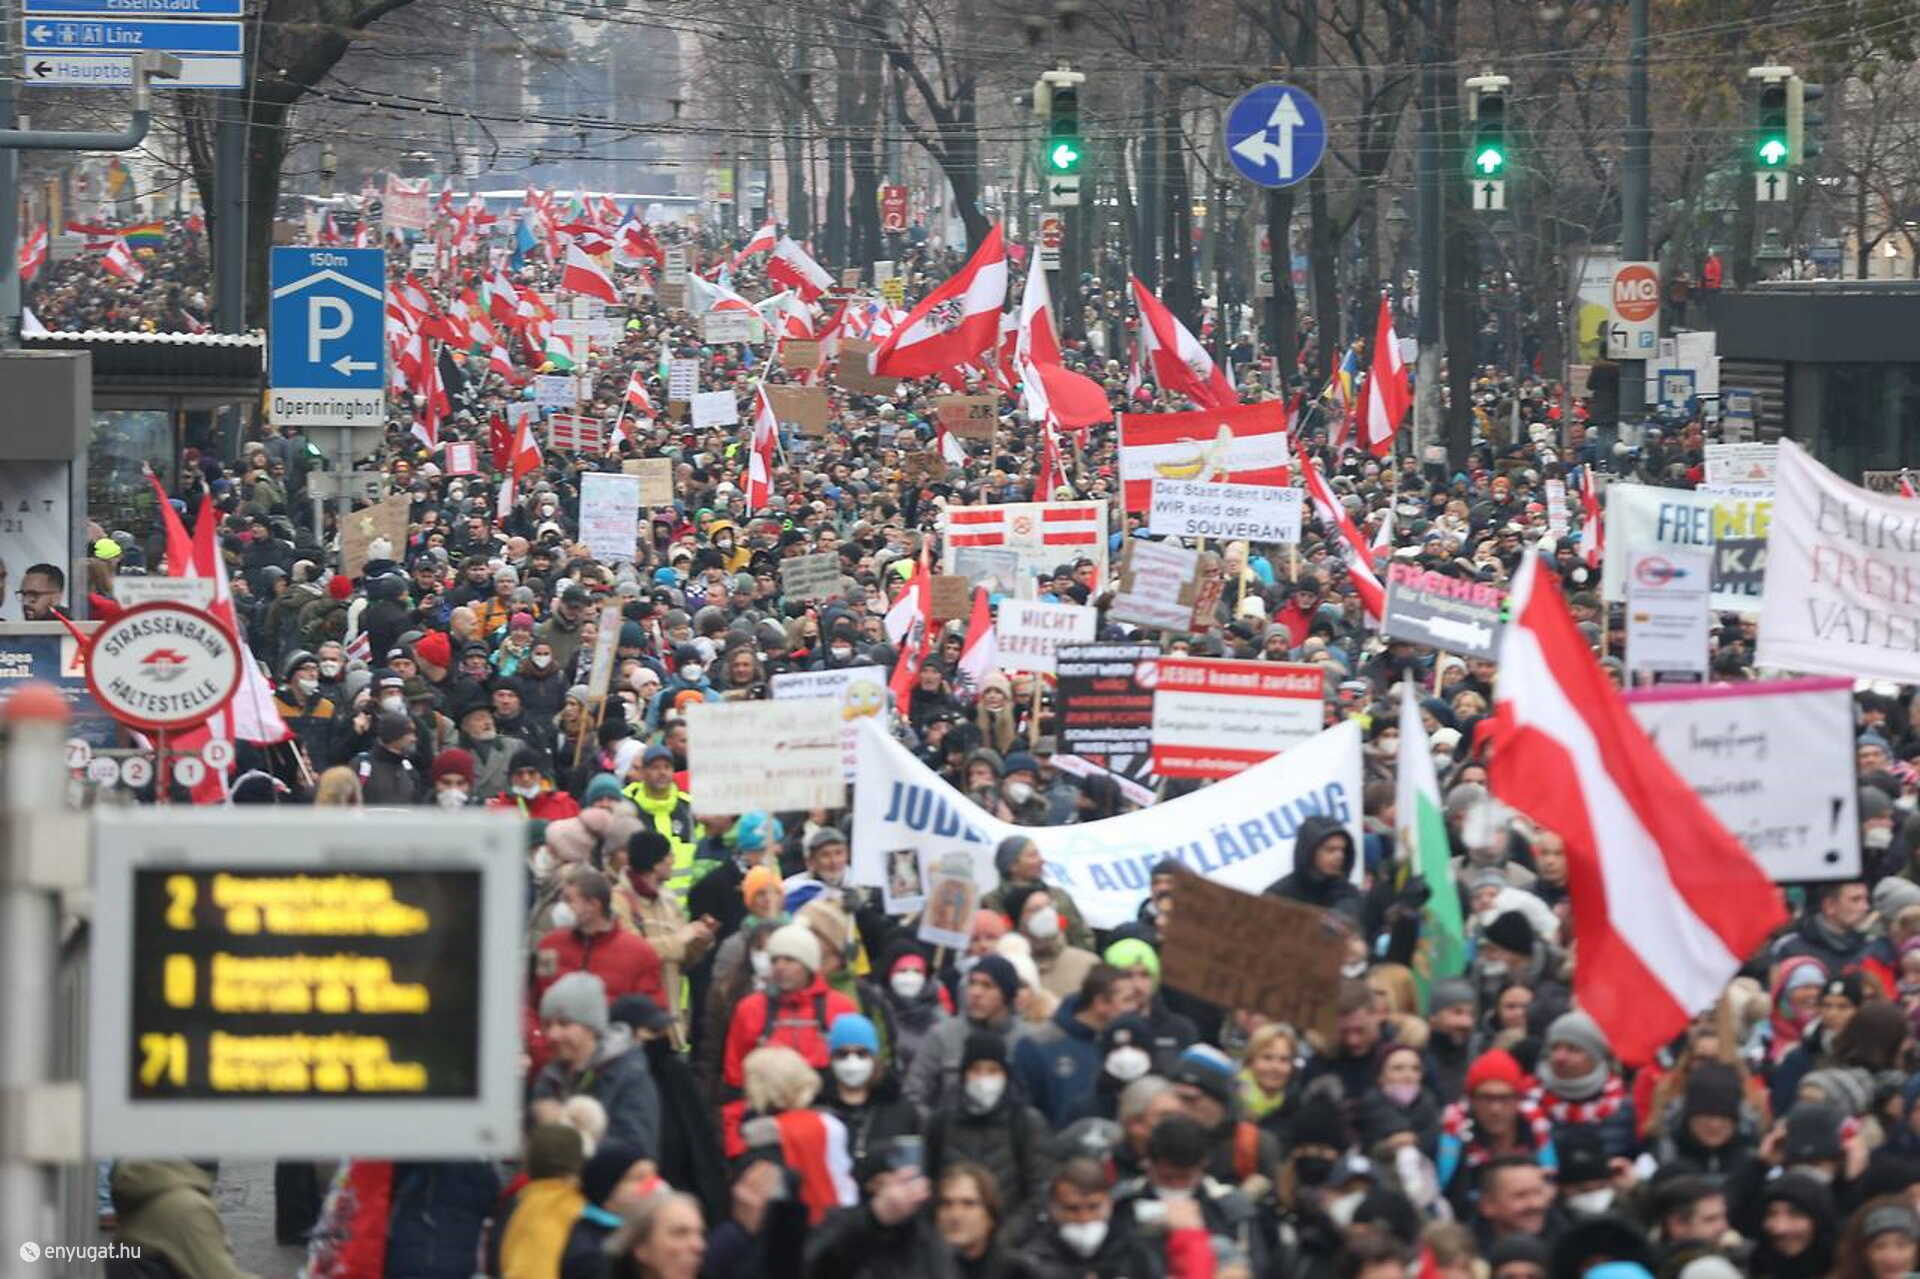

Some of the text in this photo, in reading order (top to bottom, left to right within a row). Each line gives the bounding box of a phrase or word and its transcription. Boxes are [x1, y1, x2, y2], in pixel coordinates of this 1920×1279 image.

[106, 30, 143, 44] Linz
[57, 64, 131, 80] Hauptba
[309, 253, 348, 267] 150m
[1615, 279, 1657, 300] MQ
[308, 296, 353, 362] P
[274, 396, 382, 420] Opernringhof
[1155, 501, 1250, 517] WIR sind der
[1021, 609, 1077, 629] NICHT
[104, 616, 227, 660] STRASSENBAHN
[107, 675, 220, 714] HALTESTELLE
[131, 764, 143, 780] 2
